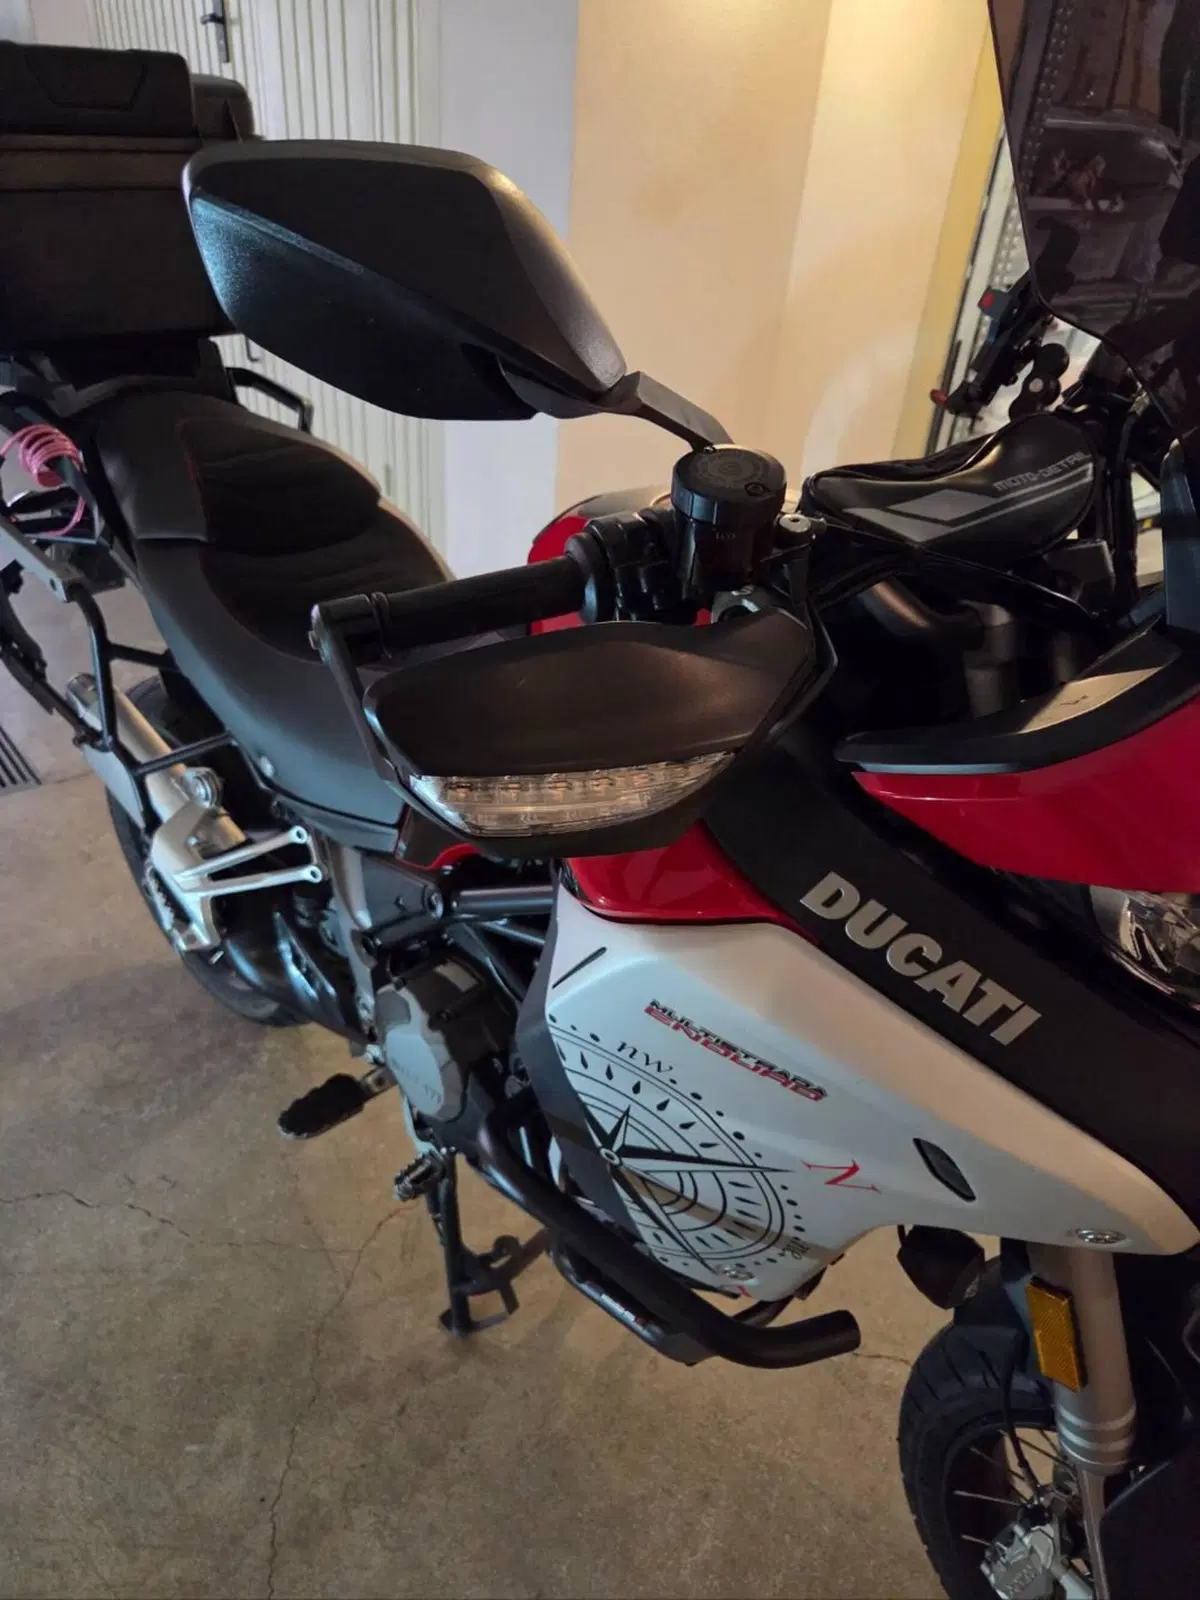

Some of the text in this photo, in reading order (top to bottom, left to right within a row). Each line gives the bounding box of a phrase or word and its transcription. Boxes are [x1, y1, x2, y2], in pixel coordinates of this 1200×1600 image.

[799, 870, 1042, 1046] DUCATI
[644, 1006, 824, 1102] ENDURO
[650, 999, 829, 1097] MULTISTRADA
[800, 1158, 882, 1195] N
